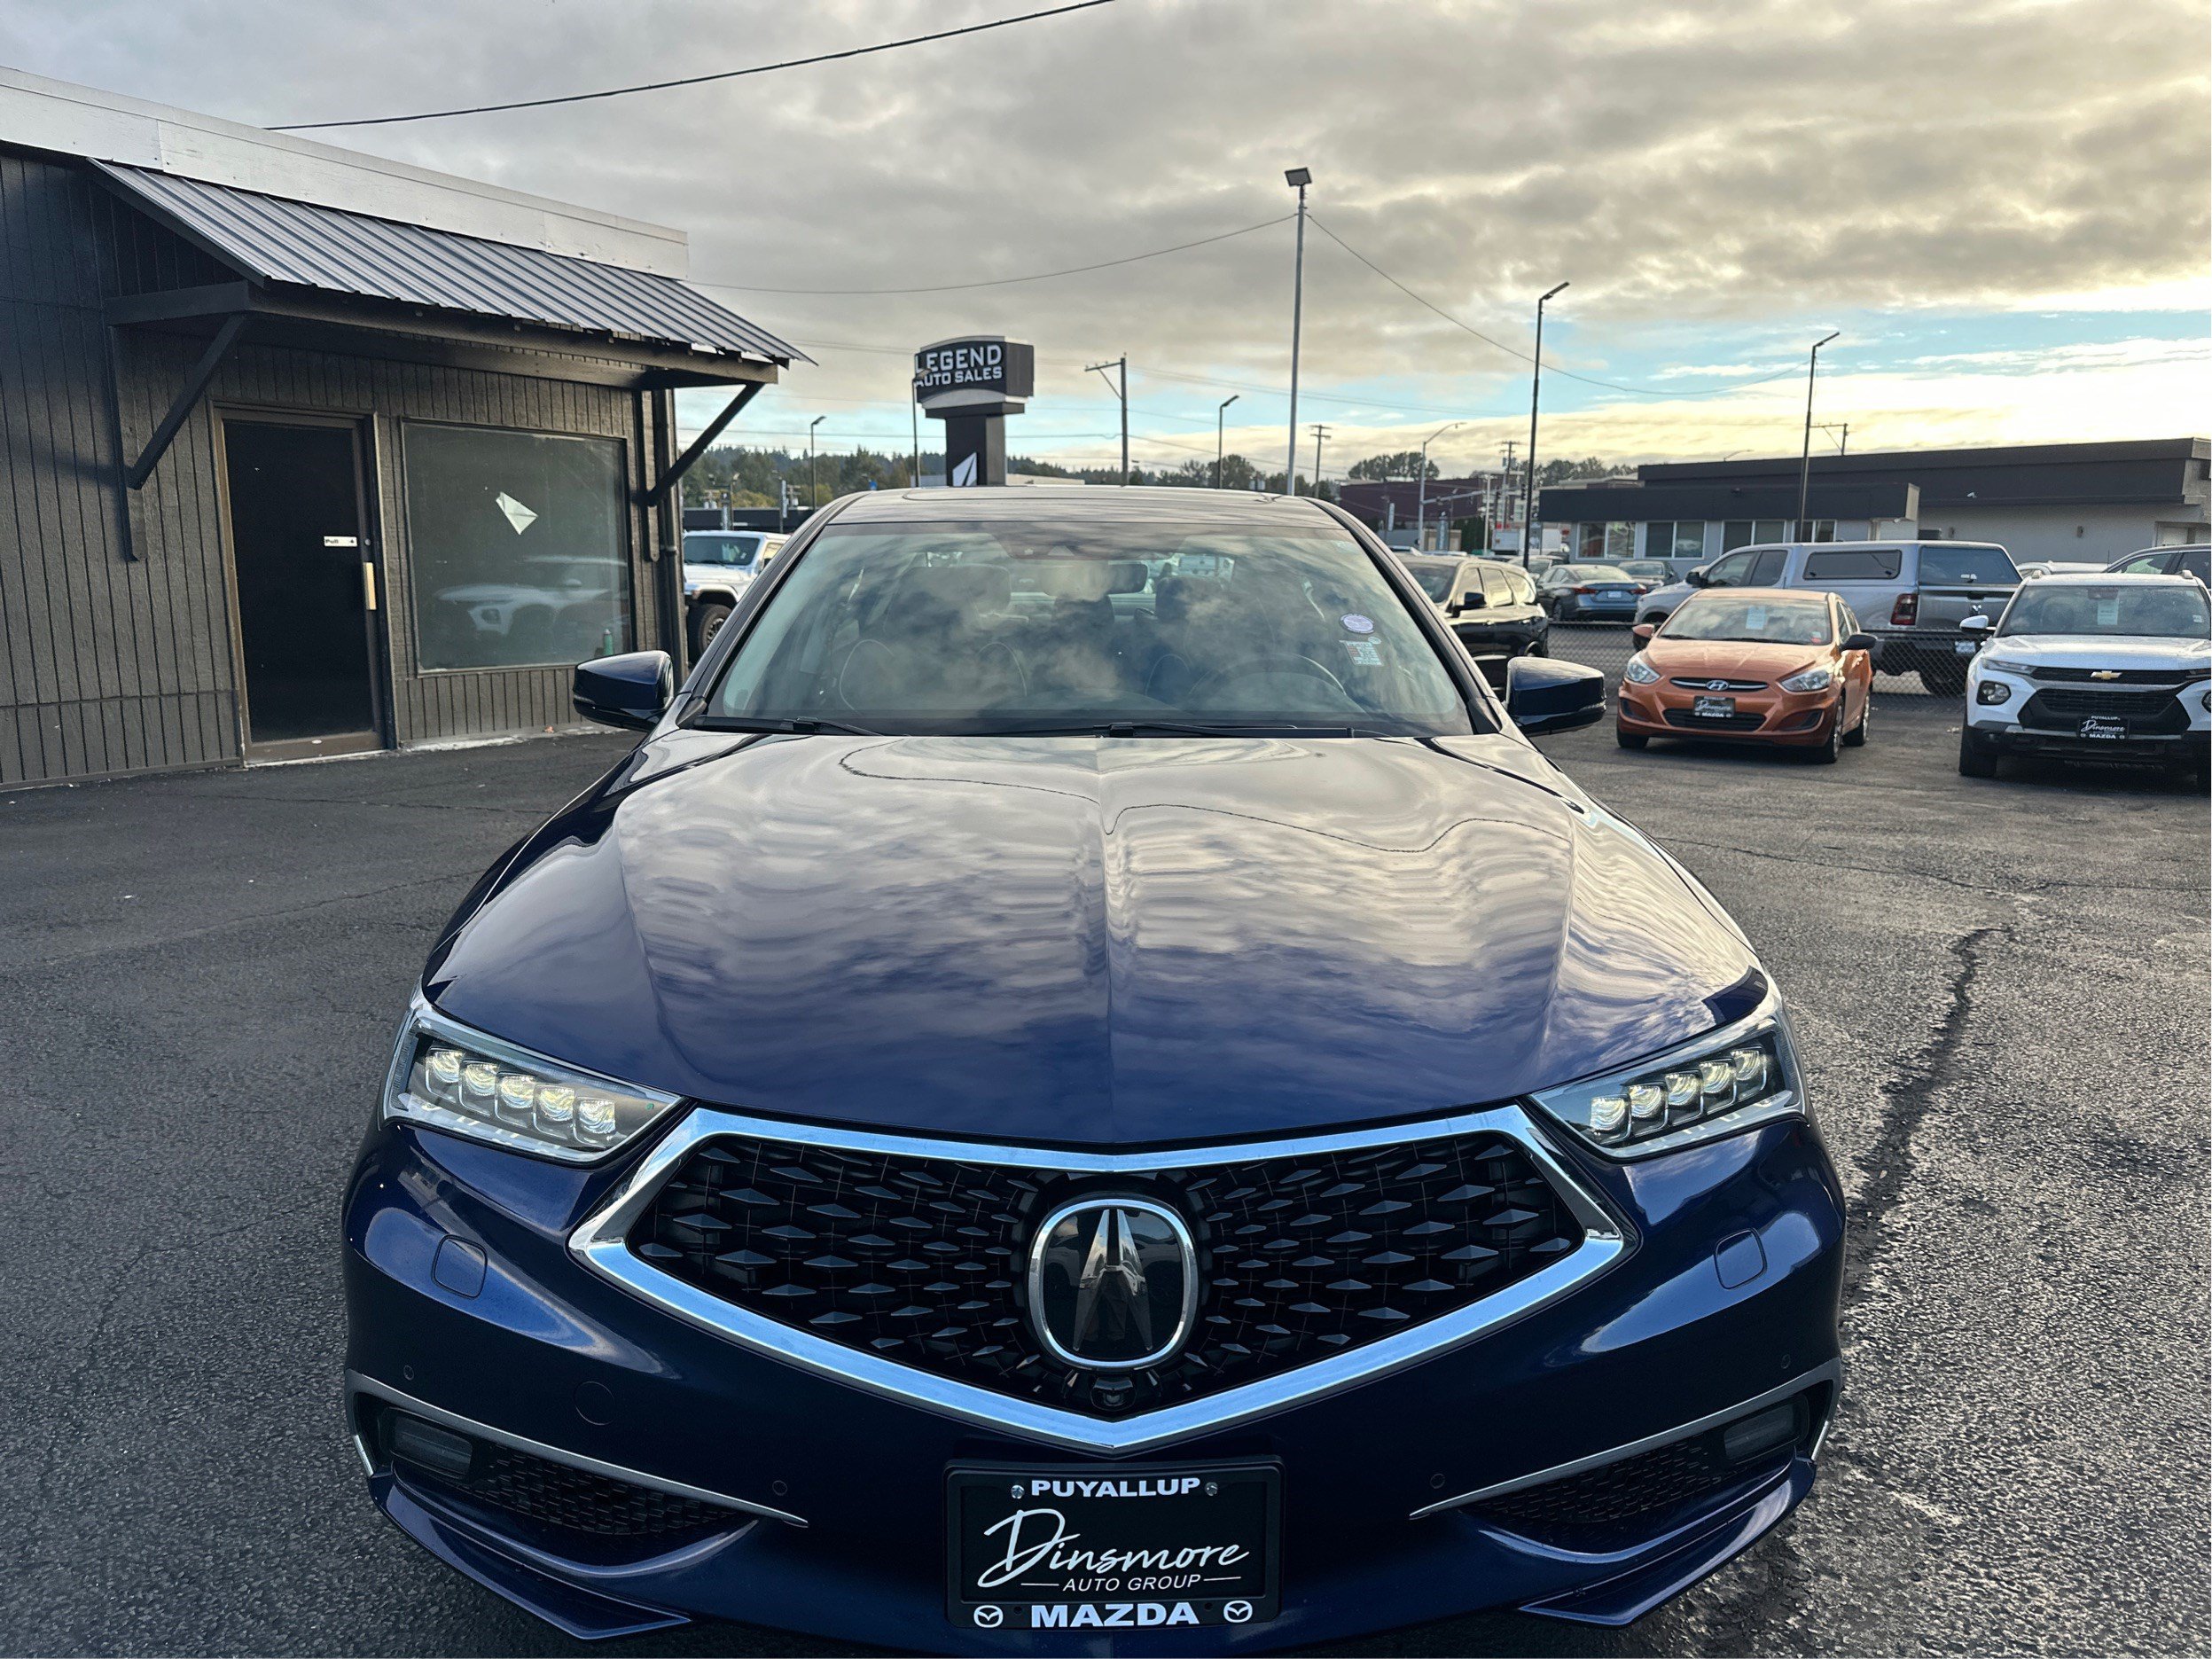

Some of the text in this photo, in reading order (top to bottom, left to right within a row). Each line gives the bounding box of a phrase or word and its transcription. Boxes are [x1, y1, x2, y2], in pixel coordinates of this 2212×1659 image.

[915, 344, 1002, 373] LEGEND
[954, 365, 1003, 383] SALES
[1031, 1478, 1200, 1498] PUYALLUP
[977, 1508, 1249, 1588] Dinsmore
[1063, 1574, 1200, 1592] AUTO GROUP
[1031, 1601, 1200, 1628] MAZDA
